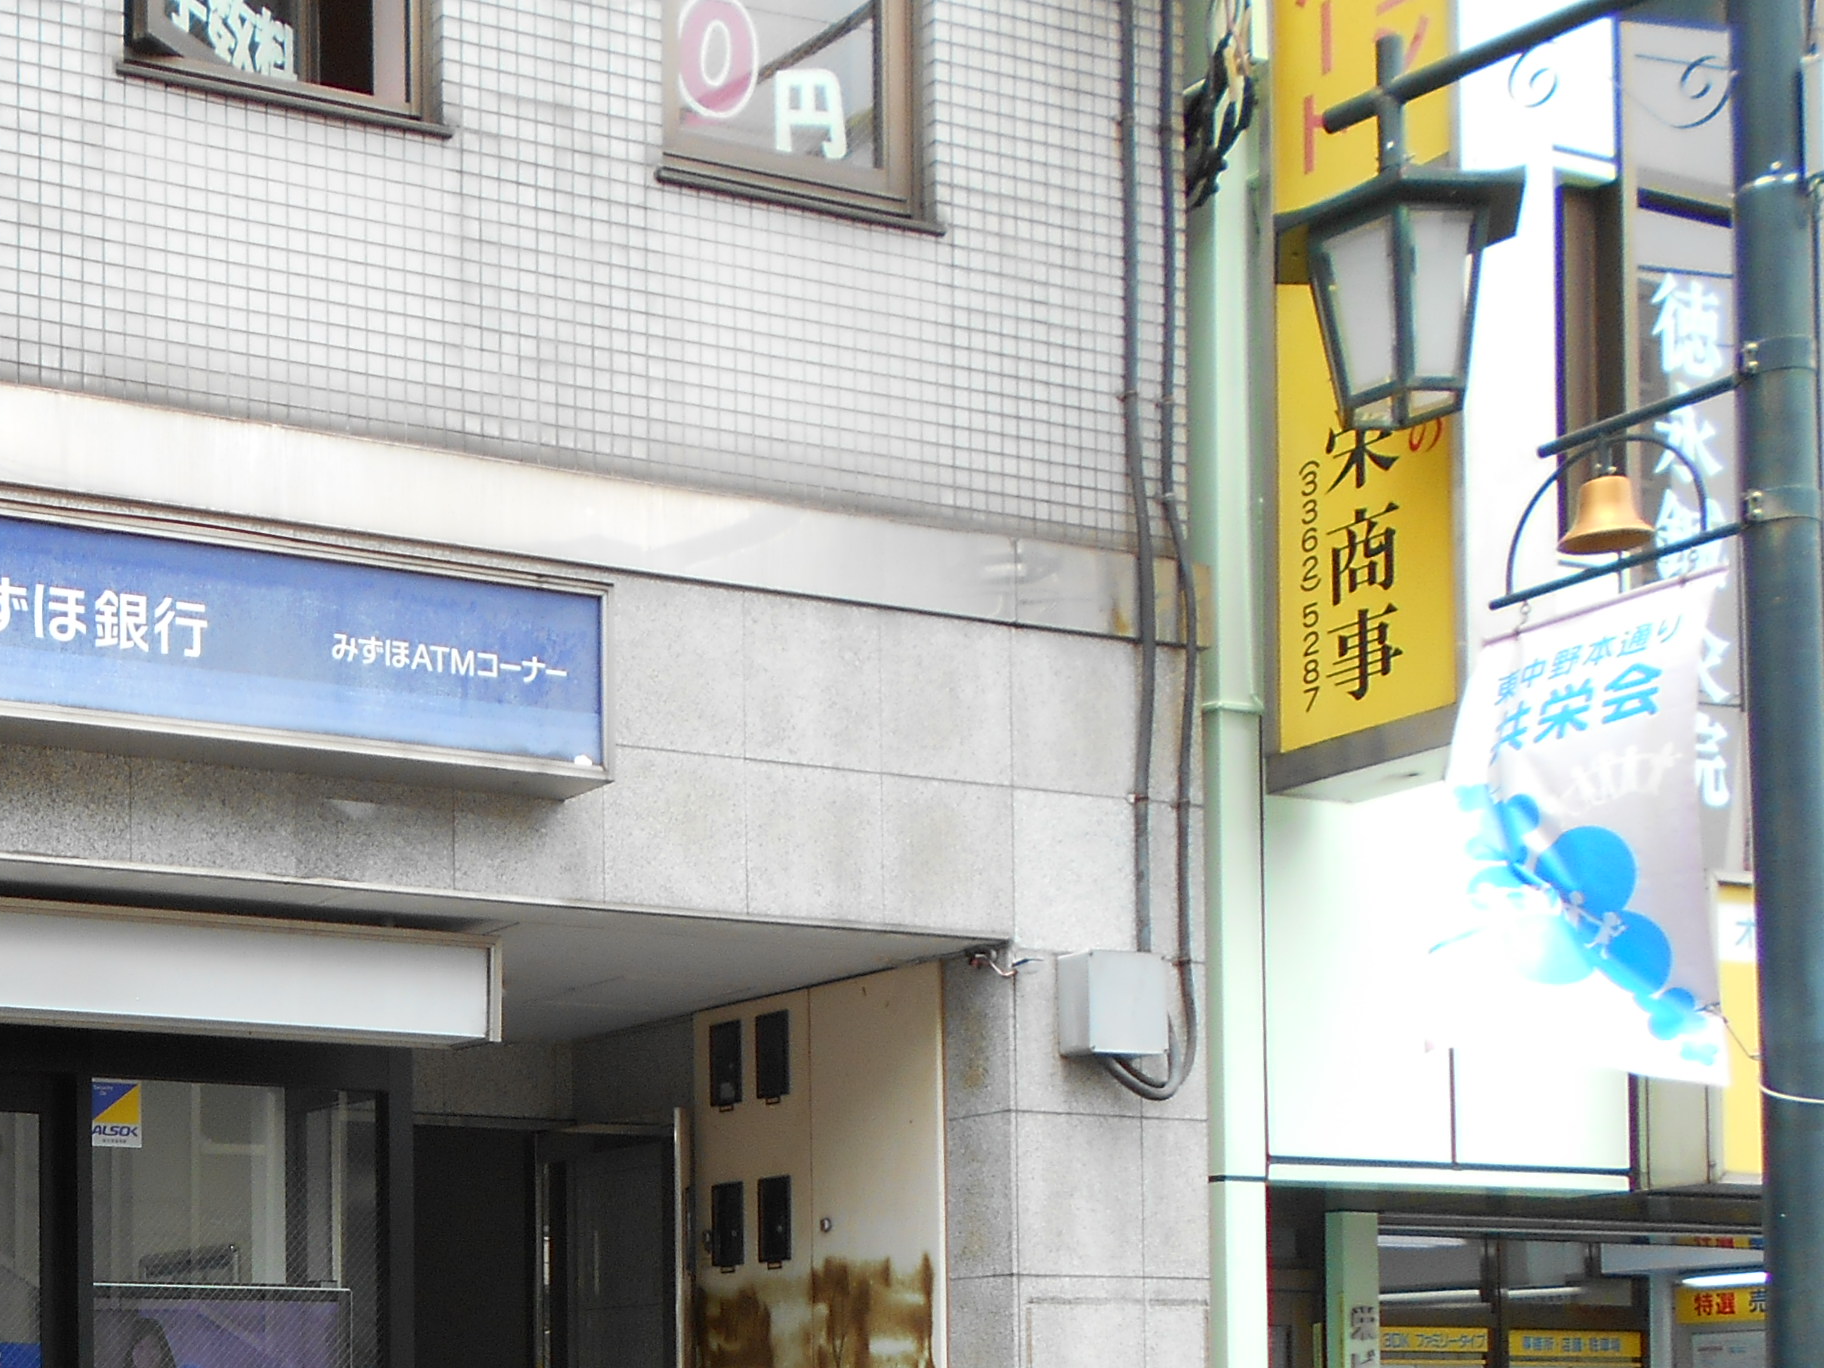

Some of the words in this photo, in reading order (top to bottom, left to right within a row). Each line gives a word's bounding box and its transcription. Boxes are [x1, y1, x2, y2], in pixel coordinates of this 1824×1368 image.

[171, 0, 297, 82] 数料
[331, 632, 568, 684] みずほATMコーナー
[1493, 613, 1683, 706] 東中野本通り
[92, 1124, 139, 1138] ALSOK
